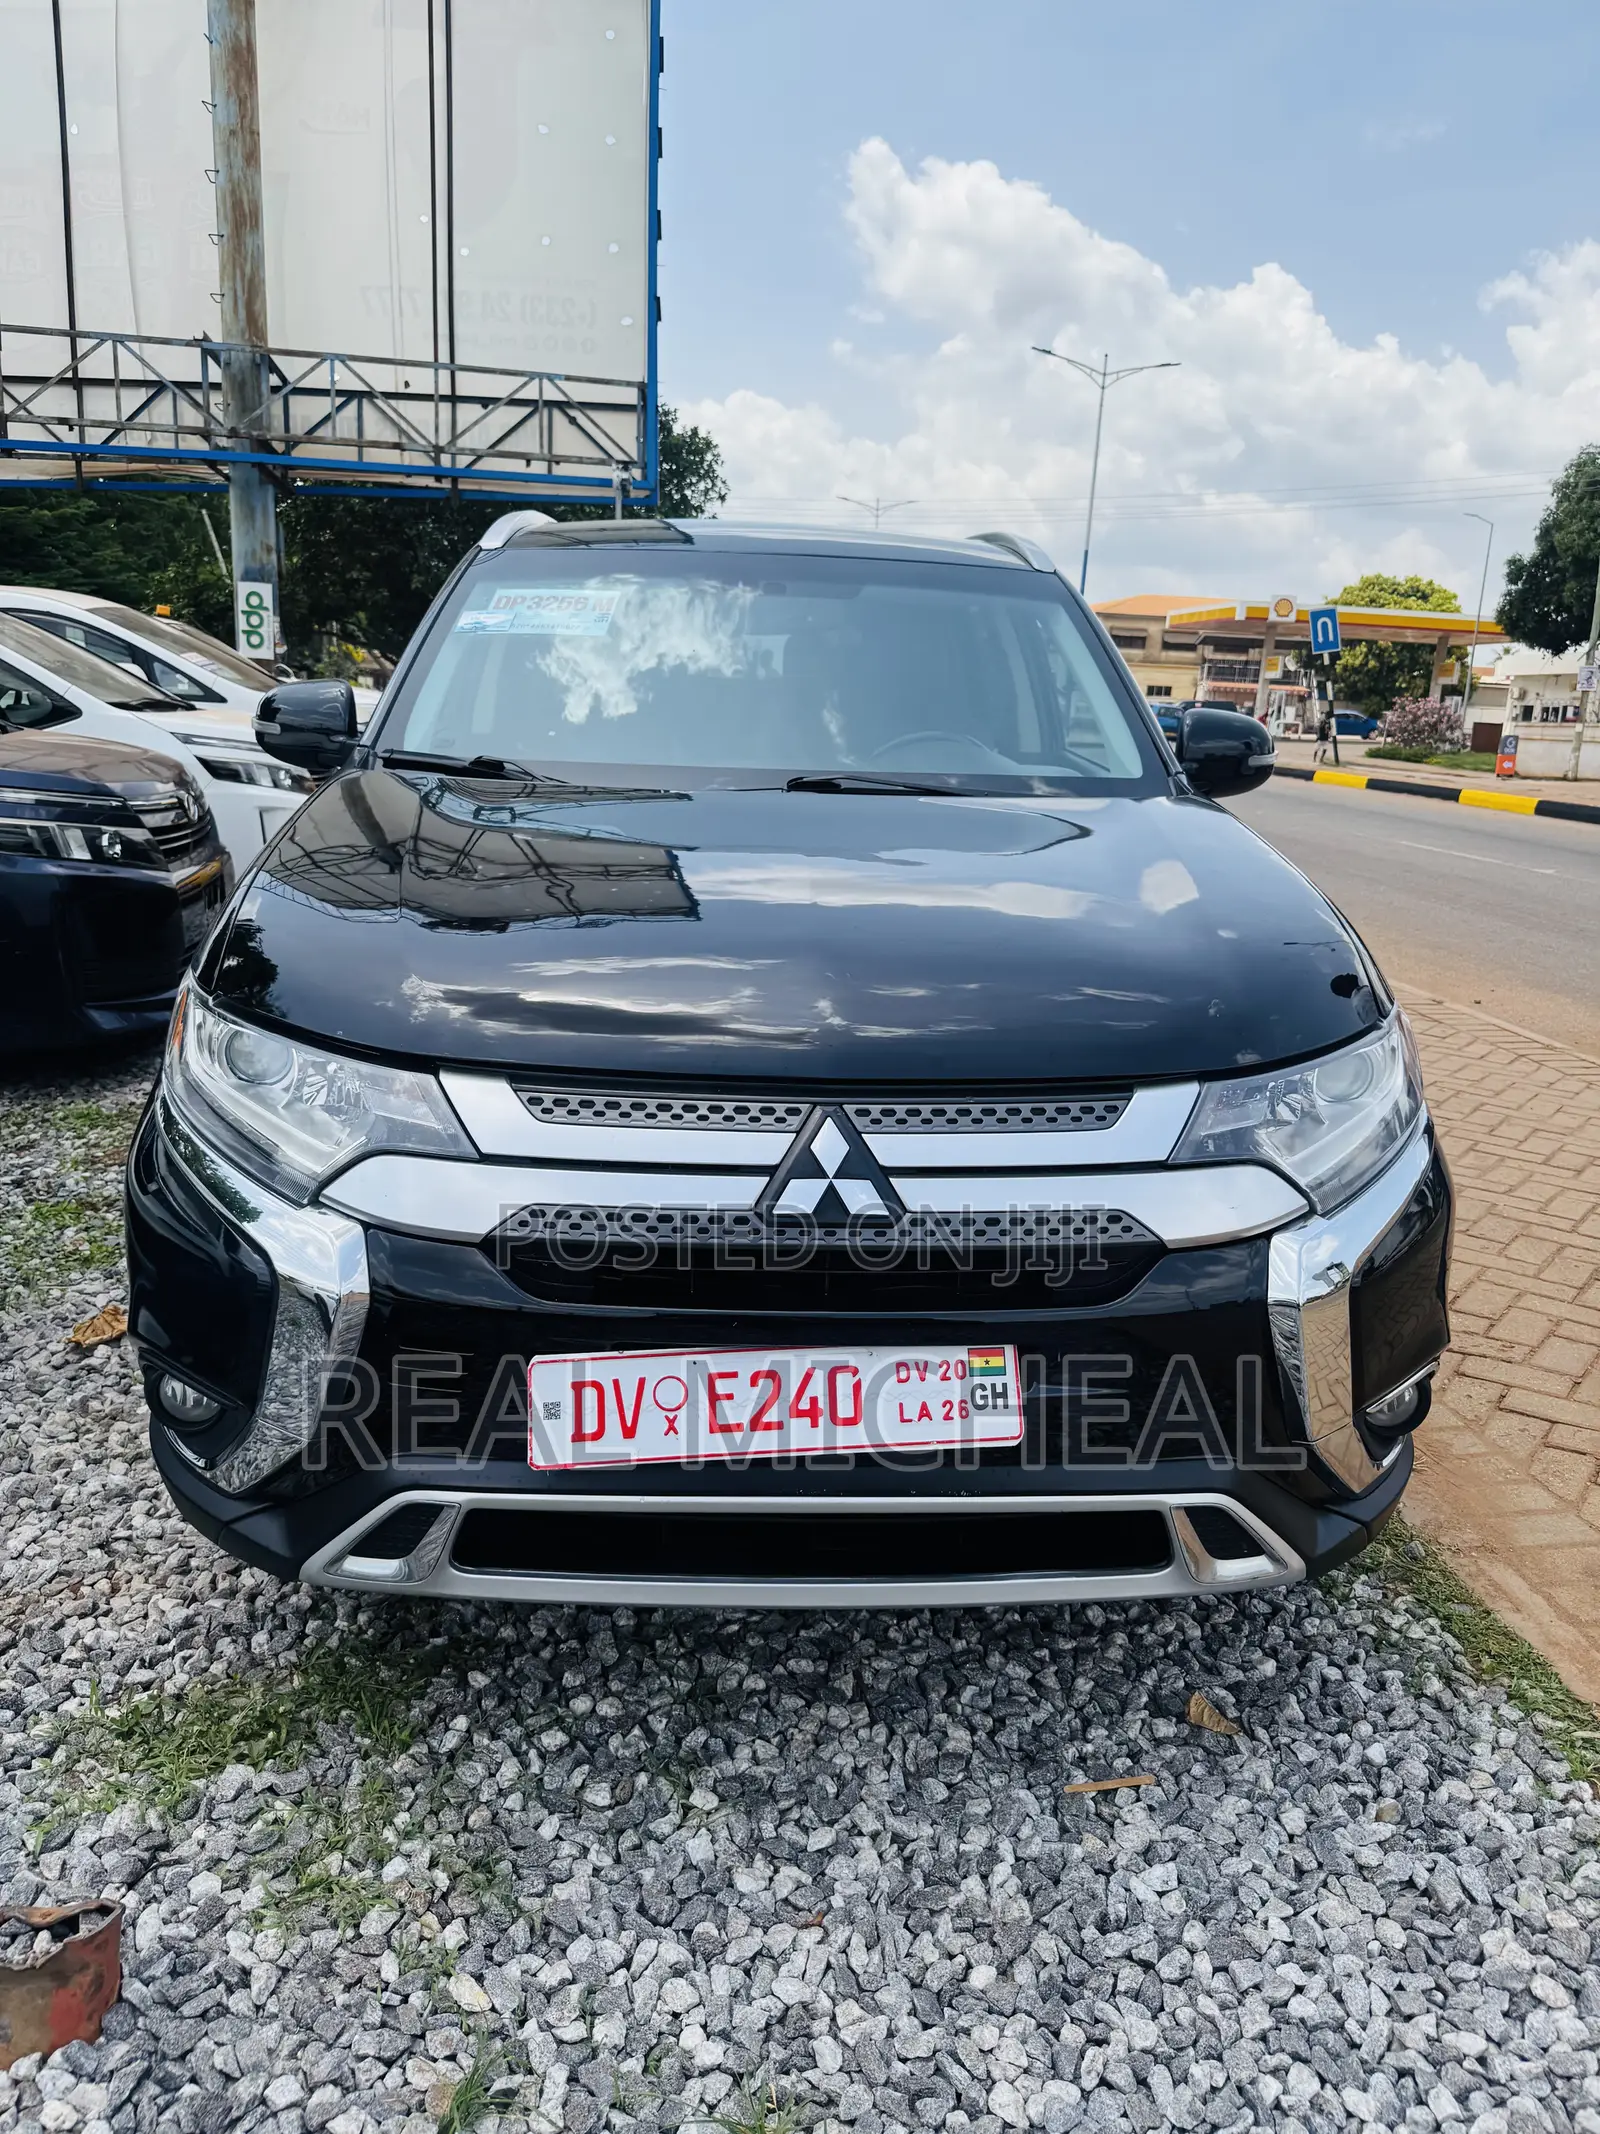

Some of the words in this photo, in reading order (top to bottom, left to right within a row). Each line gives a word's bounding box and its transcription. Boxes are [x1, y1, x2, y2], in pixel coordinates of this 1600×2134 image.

[492, 595, 528, 611] DP
[527, 595, 589, 612] 3256
[240, 590, 270, 650] ddp
[895, 1360, 930, 1385] DV
[938, 1358, 967, 1382] 20
[569, 1376, 646, 1443] DV
[707, 1364, 863, 1435] E240
[970, 1381, 1010, 1412] GH
[899, 1400, 933, 1425] LA
[942, 1398, 971, 1422] 26
